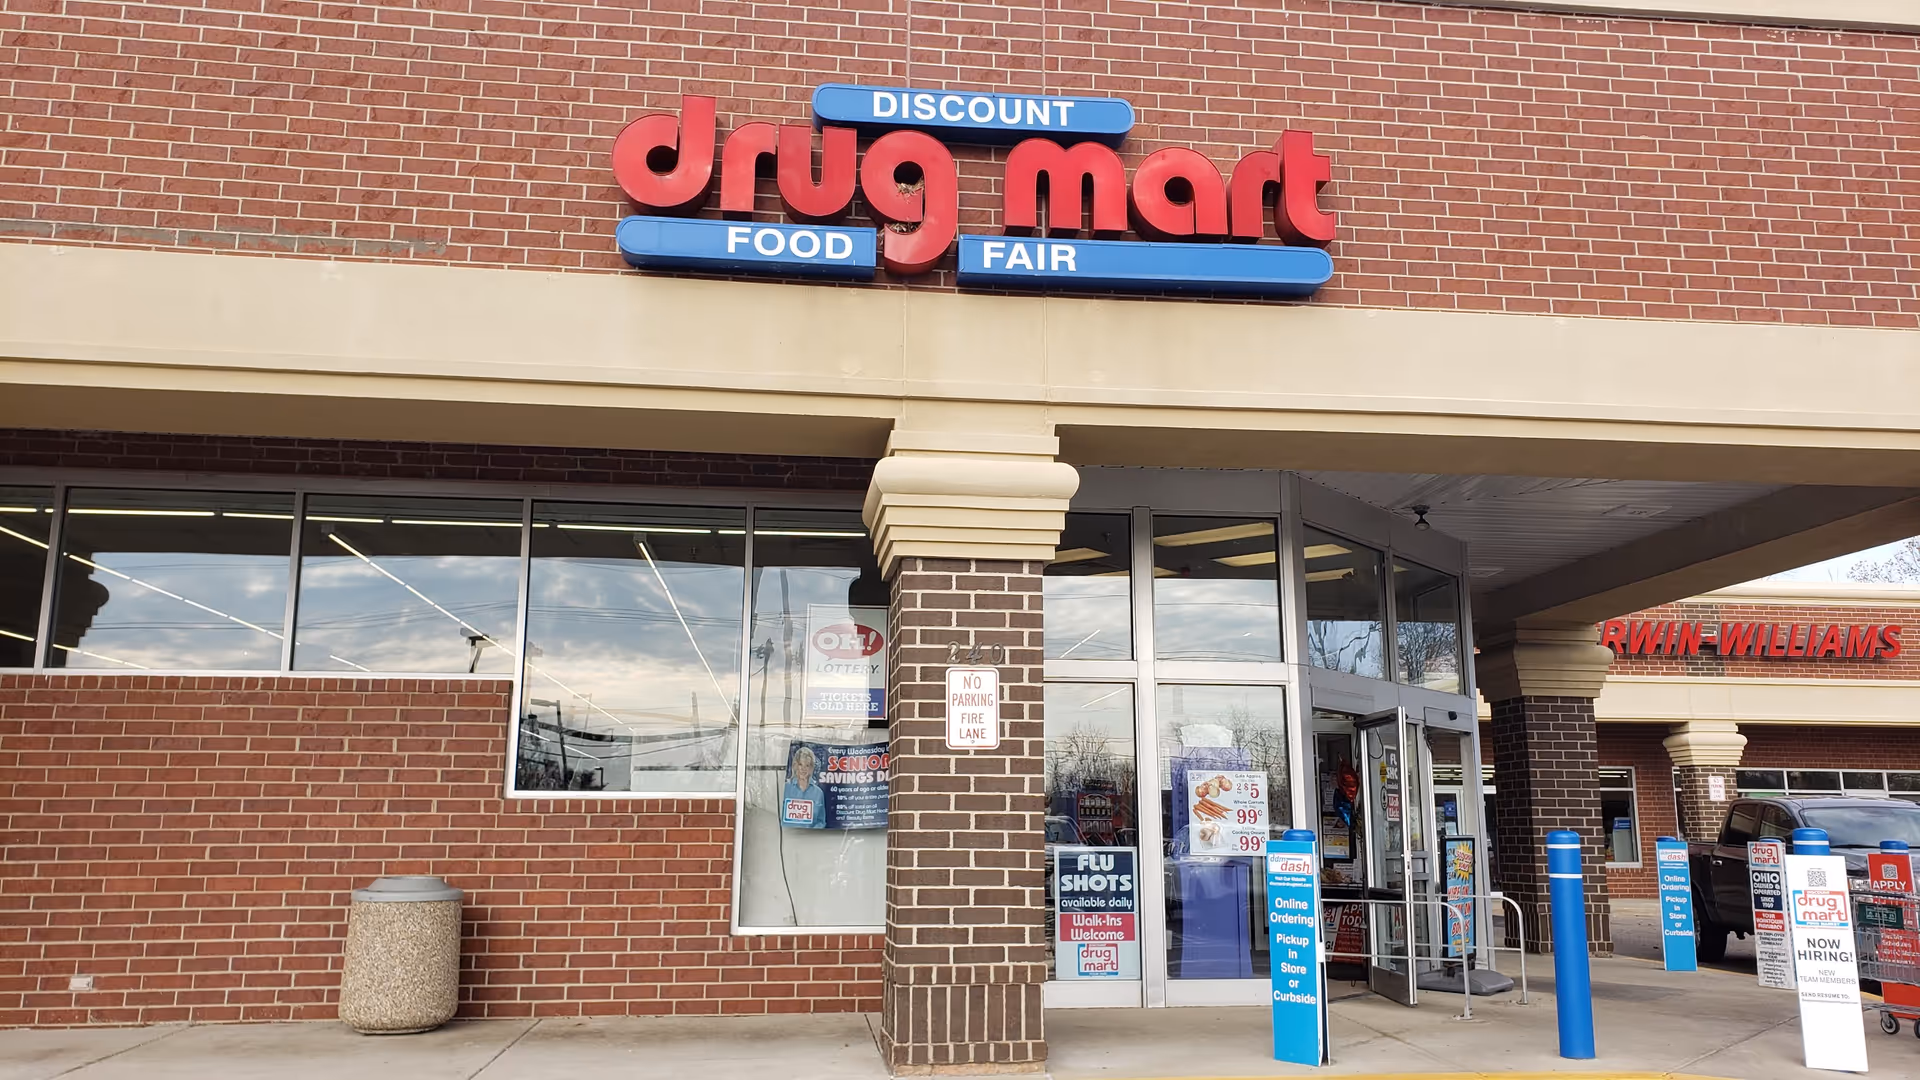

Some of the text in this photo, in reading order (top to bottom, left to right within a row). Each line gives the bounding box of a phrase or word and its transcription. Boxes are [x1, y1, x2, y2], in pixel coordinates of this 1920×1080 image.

[873, 91, 1075, 128] DISCOUNT
[612, 94, 1336, 265] drug mart
[727, 226, 1078, 272] FOOD FAIR
[816, 630, 877, 652] OH!
[946, 641, 1005, 666] 240
[816, 663, 879, 674] LOTTERY
[963, 675, 982, 690] NO
[820, 692, 872, 702] TICKETS
[952, 693, 994, 707] PARKING
[812, 702, 879, 712] SOLD HERE
[961, 712, 985, 724] FIRE
[959, 728, 987, 740] LANE
[828, 747, 846, 756] Every
[847, 746, 885, 756] Wednesday
[827, 753, 890, 772] SENIOR
[819, 771, 874, 784] SAVINGS
[1236, 783, 1242, 791] 2
[787, 801, 808, 812] drug
[788, 811, 812, 820] mart
[1752, 842, 1773, 857] drug
[1077, 854, 1115, 872] FLU
[1667, 853, 1687, 861] dash
[1754, 856, 1779, 865] mart
[1280, 860, 1313, 875] dash
[1060, 874, 1133, 892] SHOTS
[1752, 872, 1780, 883] OHIO
[1661, 884, 1690, 892] Ordering
[1872, 880, 1907, 891] APPLY
[1061, 896, 1133, 910] available daily
[1275, 897, 1309, 910] Online
[1665, 896, 1688, 904] Pickup
[1797, 894, 1838, 911] drug
[1072, 914, 1122, 927] Walk-Ins
[1270, 911, 1315, 928] Ordering
[1669, 912, 1687, 920] Store
[1802, 910, 1848, 922] mart
[1070, 928, 1125, 940] Welcome
[1276, 933, 1310, 948] Pickup
[1806, 937, 1841, 950] NOW
[1080, 943, 1112, 962] drug
[1288, 948, 1298, 959] in
[1797, 950, 1854, 963] HIRING!
[1084, 960, 1119, 971] mart
[1280, 961, 1307, 975] Store
[1818, 969, 1836, 977] NEW
[1288, 979, 1300, 989] or
[1820, 976, 1857, 985] MEMBERS
[1273, 989, 1317, 1005] Curbside
